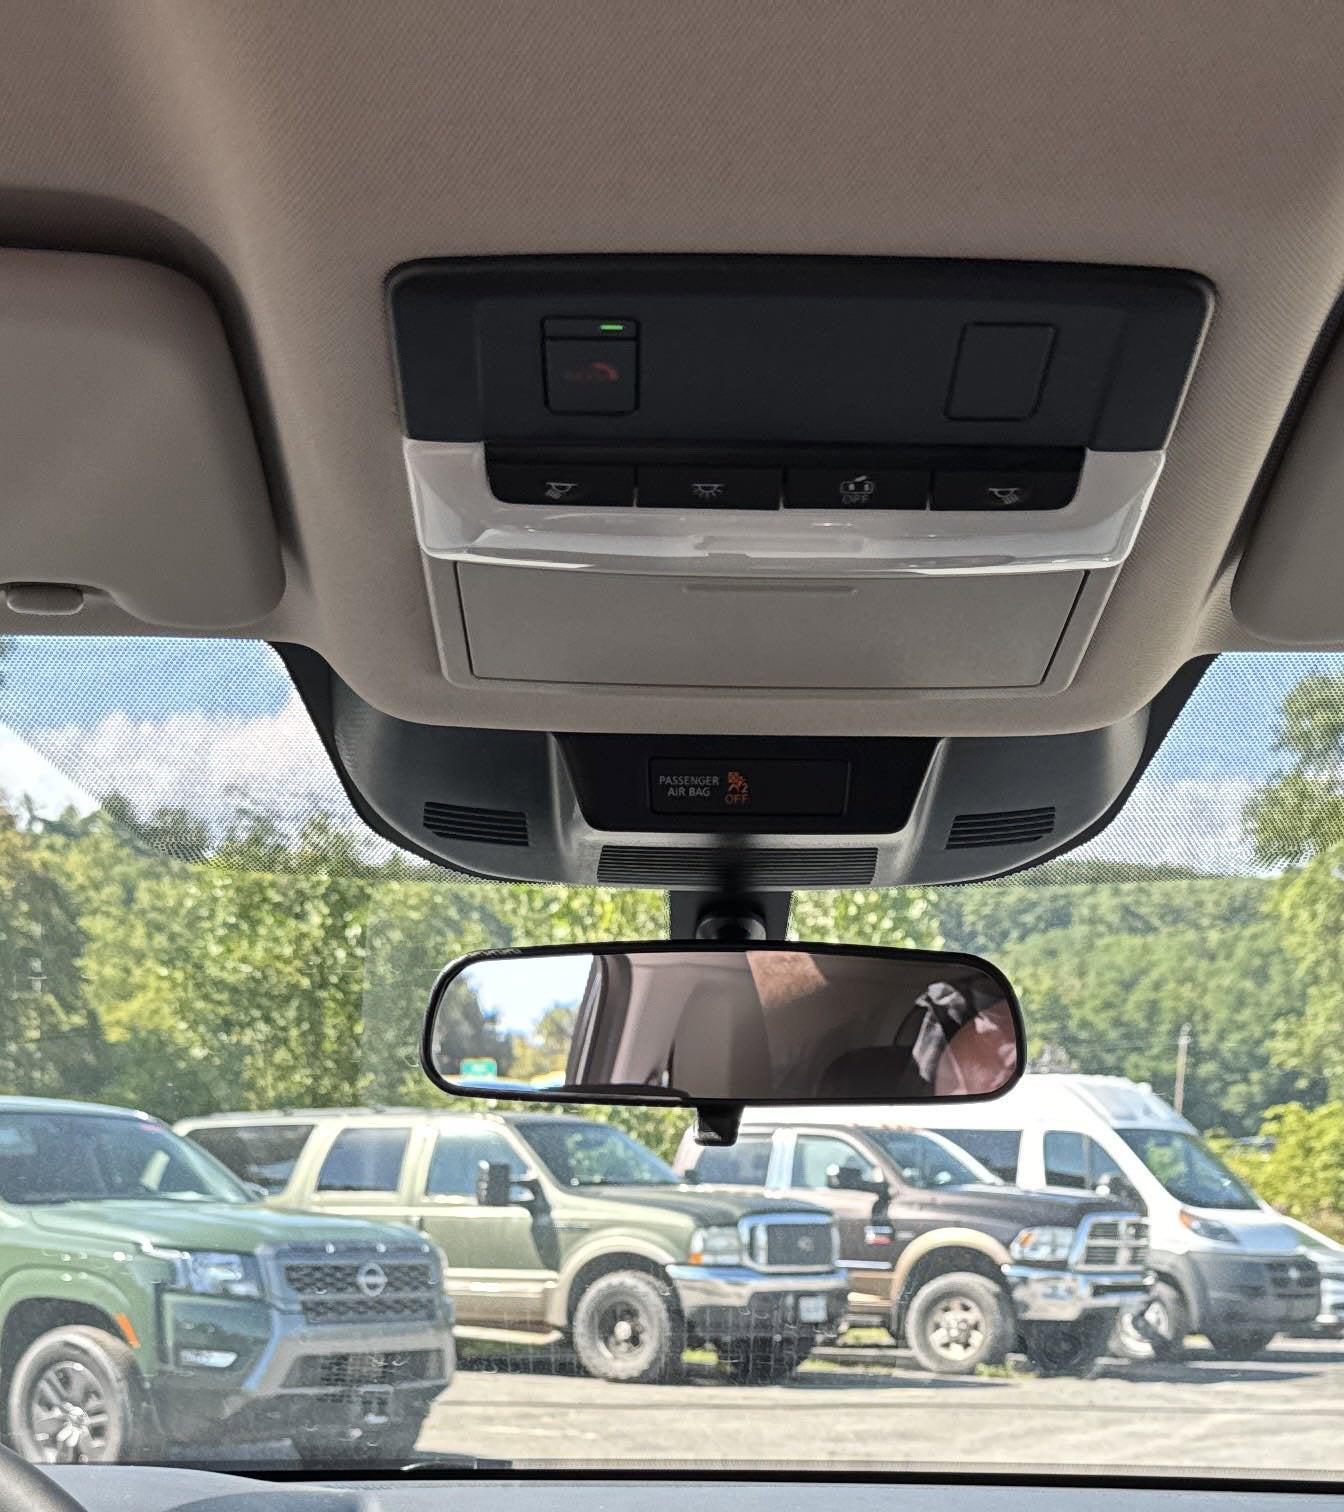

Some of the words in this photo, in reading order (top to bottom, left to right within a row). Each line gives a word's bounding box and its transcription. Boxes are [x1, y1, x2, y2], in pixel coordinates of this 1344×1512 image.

[659, 775, 720, 786] PASSENGER
[667, 787, 686, 797] AIR
[688, 787, 710, 797] BAG
[725, 794, 749, 805] OFF
